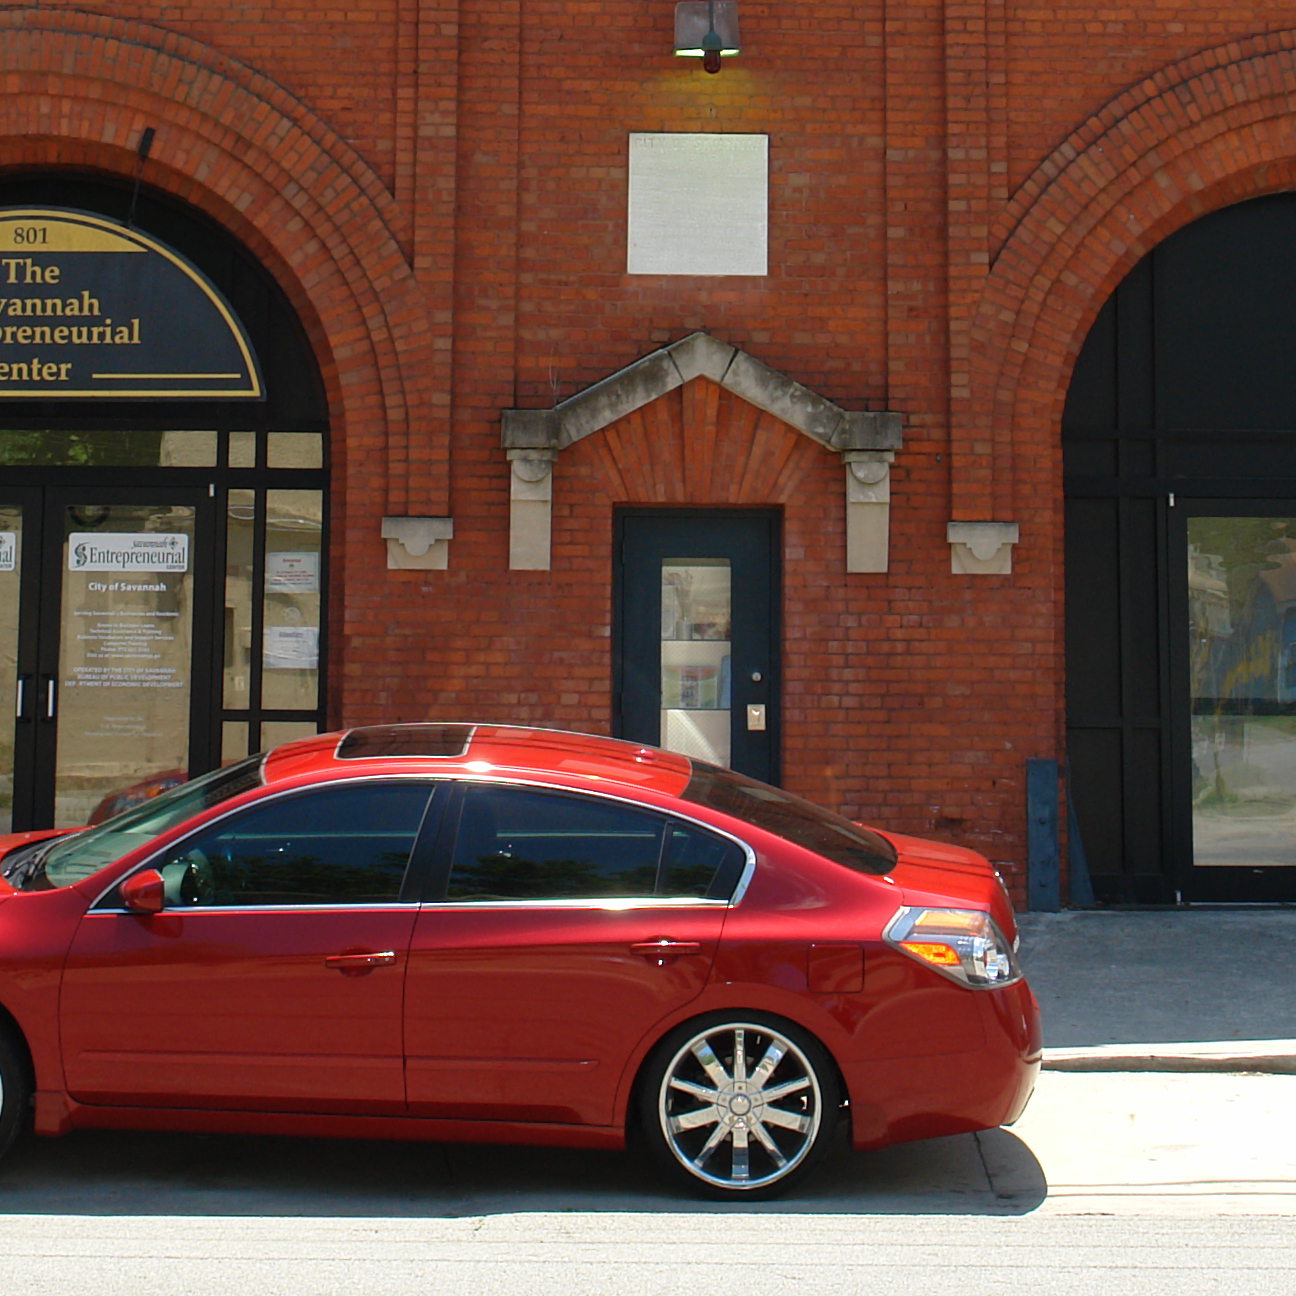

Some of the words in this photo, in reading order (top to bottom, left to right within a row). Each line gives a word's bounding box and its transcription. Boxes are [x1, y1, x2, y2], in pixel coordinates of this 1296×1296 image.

[13, 227, 49, 245] 801
[2, 258, 60, 284] The
[89, 547, 185, 568] Entrepreneurial
[89, 582, 106, 592] City
[109, 582, 119, 591] of
[120, 582, 167, 591] Savannah
